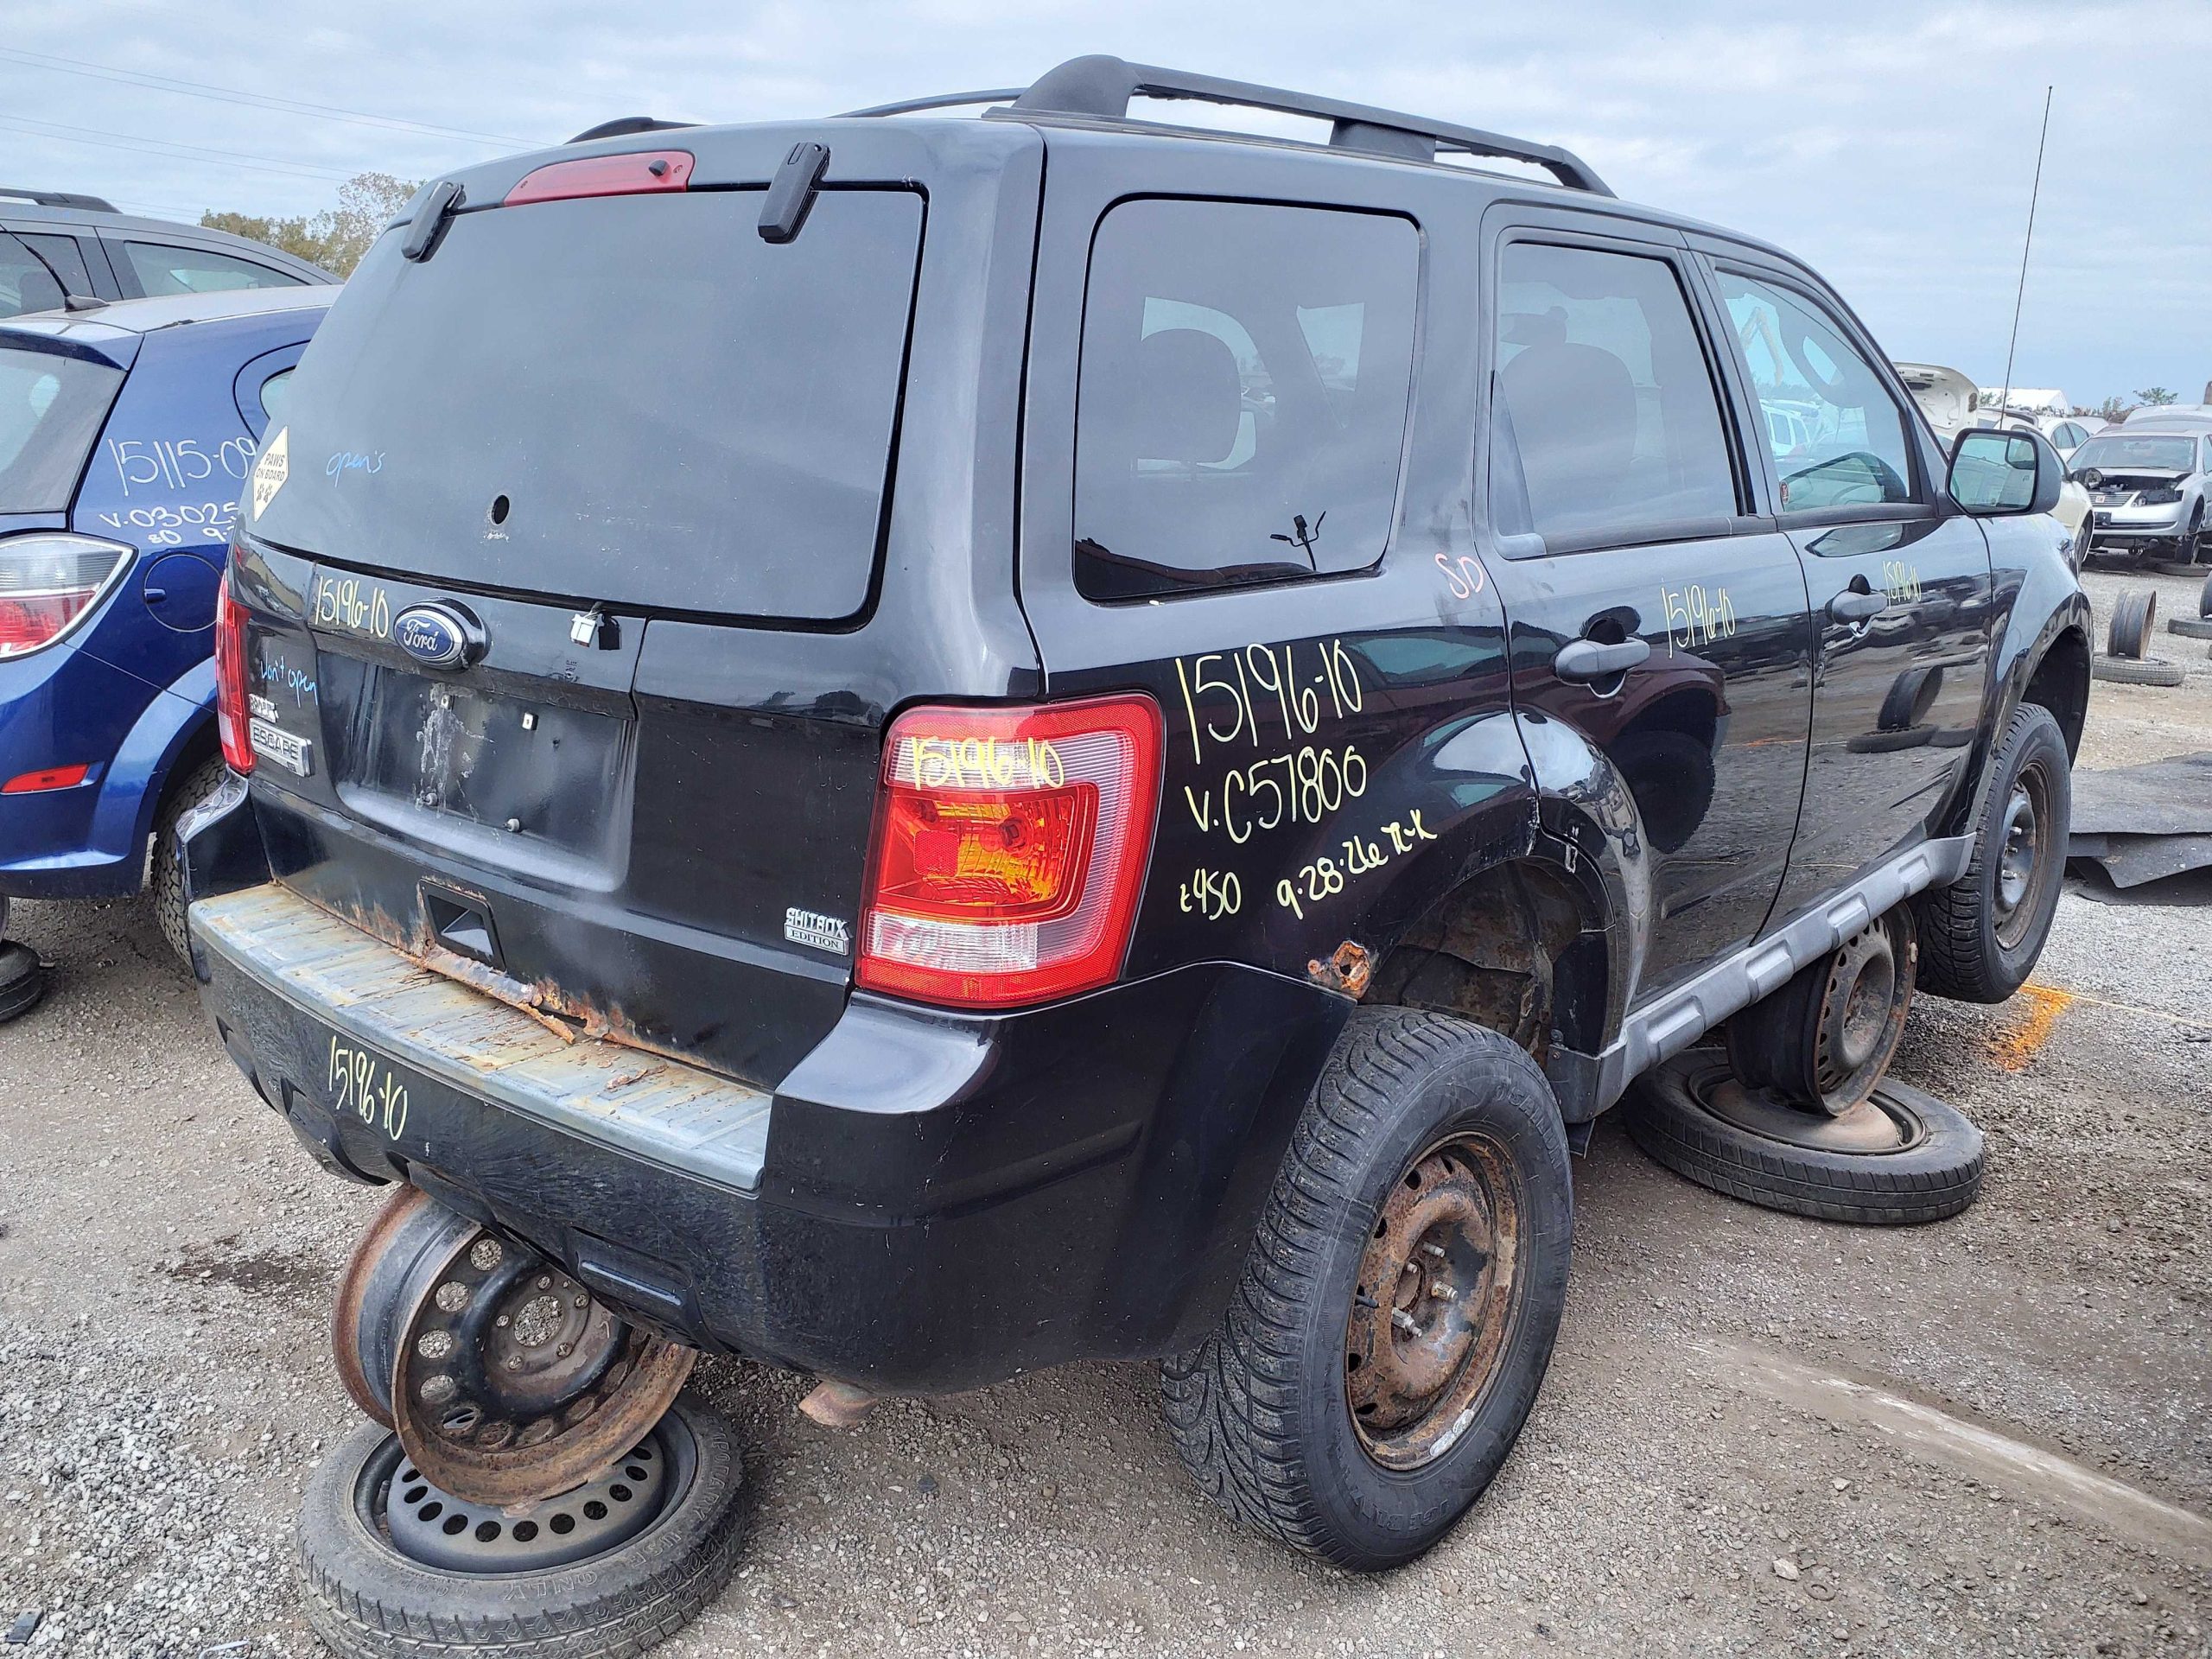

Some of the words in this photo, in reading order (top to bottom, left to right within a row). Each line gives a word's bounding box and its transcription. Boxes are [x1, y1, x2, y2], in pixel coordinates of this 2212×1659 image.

[256, 468, 264, 478] ON
[264, 469, 285, 481] BOARD
[264, 453, 285, 467] PAWS
[1434, 553, 1484, 599] SD
[315, 575, 390, 639] 15196-10
[1661, 584, 1736, 659] 15196-10
[403, 619, 439, 652] Ford
[288, 668, 319, 709] open
[1175, 639, 1363, 765] 15196-10
[253, 727, 299, 760] ESCAPE
[785, 907, 848, 939] SHITBOX
[791, 929, 839, 949] EDITION
[328, 1034, 409, 1141] 15196-10
[503, 1570, 599, 1602] ONLY
